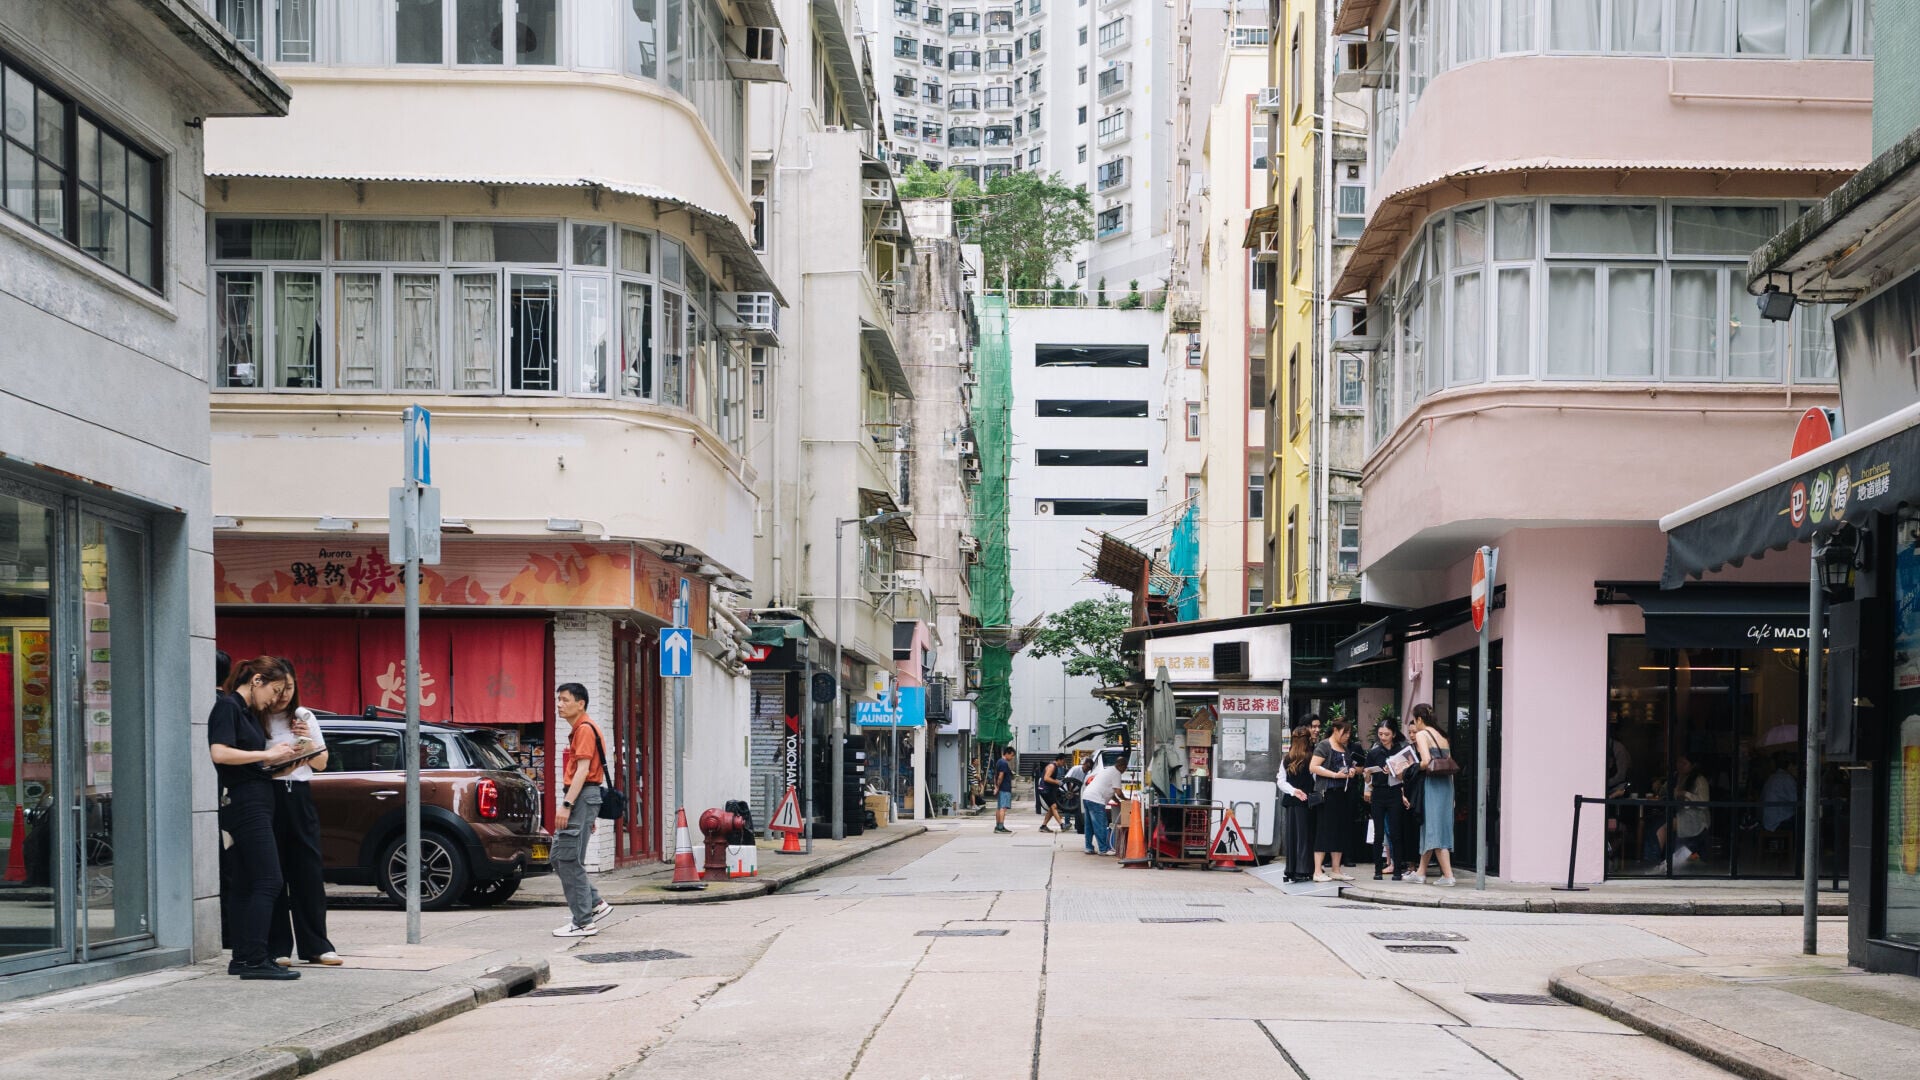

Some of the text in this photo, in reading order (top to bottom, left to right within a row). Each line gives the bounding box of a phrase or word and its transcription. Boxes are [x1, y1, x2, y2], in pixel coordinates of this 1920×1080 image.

[319, 548, 352, 558] Aurora
[1747, 624, 1771, 644] Café
[1222, 697, 1280, 712] 炳記茶檔
